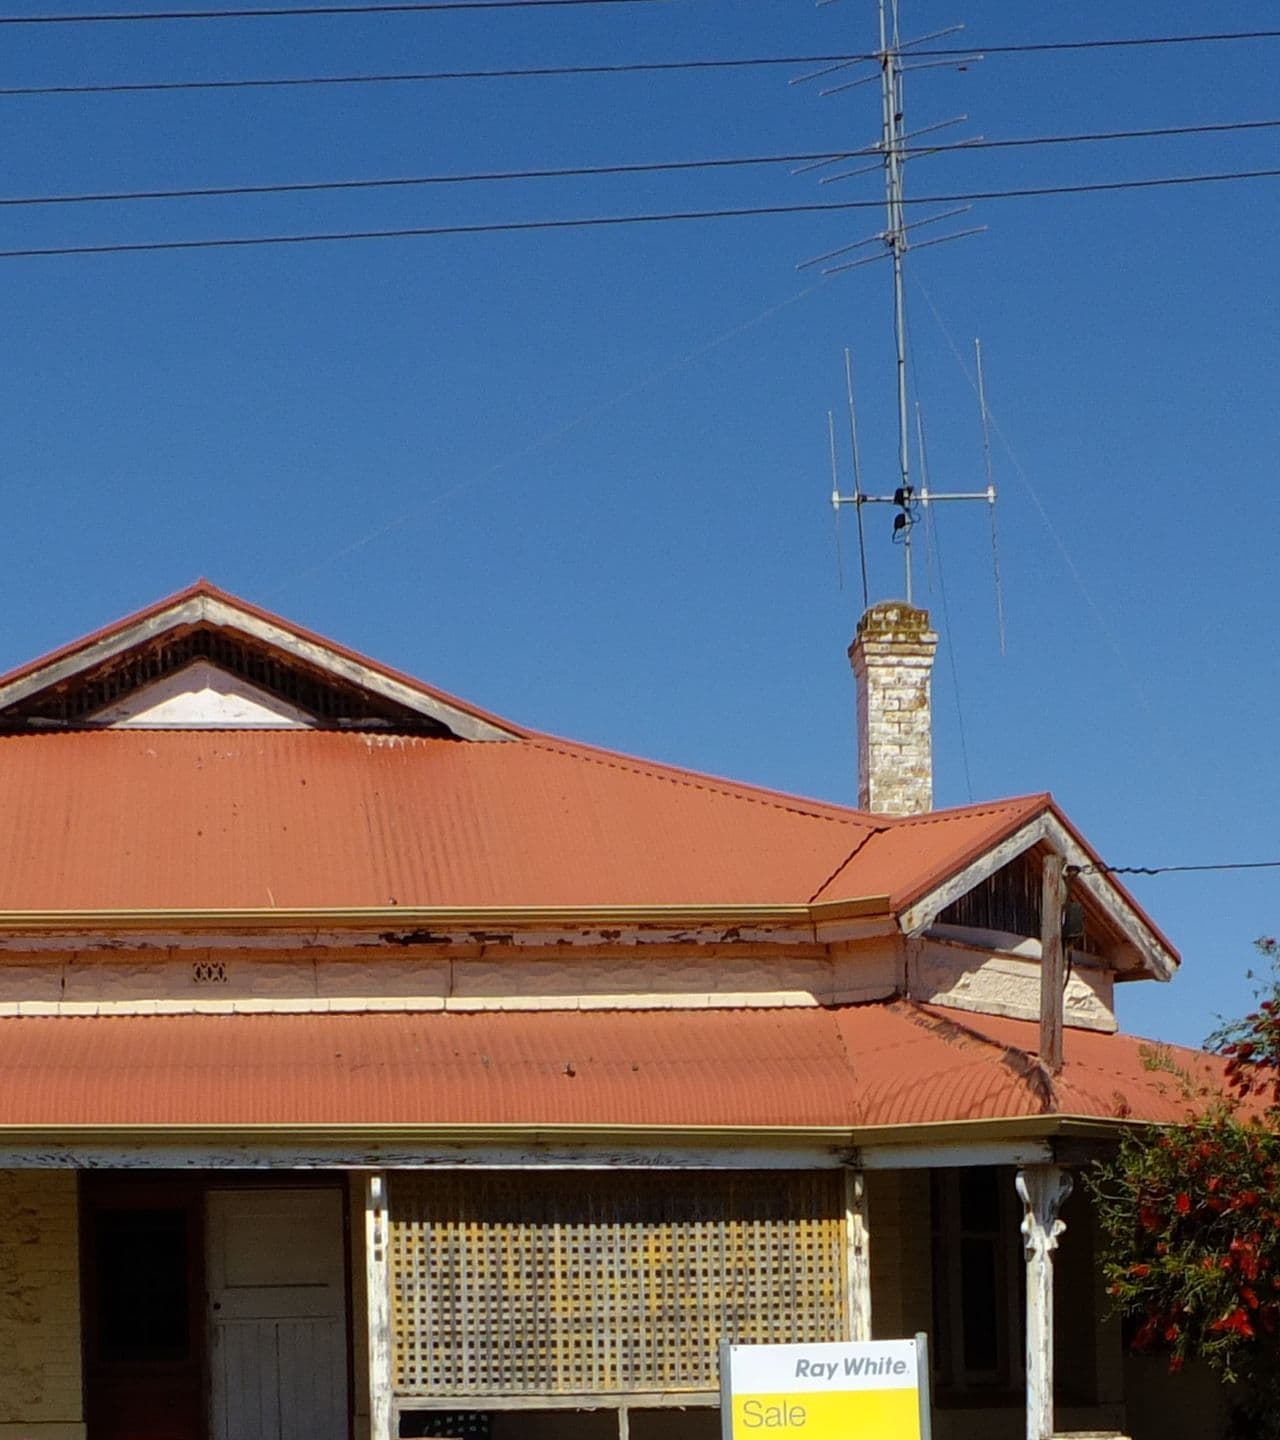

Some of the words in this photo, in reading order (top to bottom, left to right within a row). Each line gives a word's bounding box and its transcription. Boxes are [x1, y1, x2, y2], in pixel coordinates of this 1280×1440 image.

[795, 1357, 838, 1380] Ray
[844, 1356, 907, 1377] White
[742, 1400, 807, 1428] Sale
